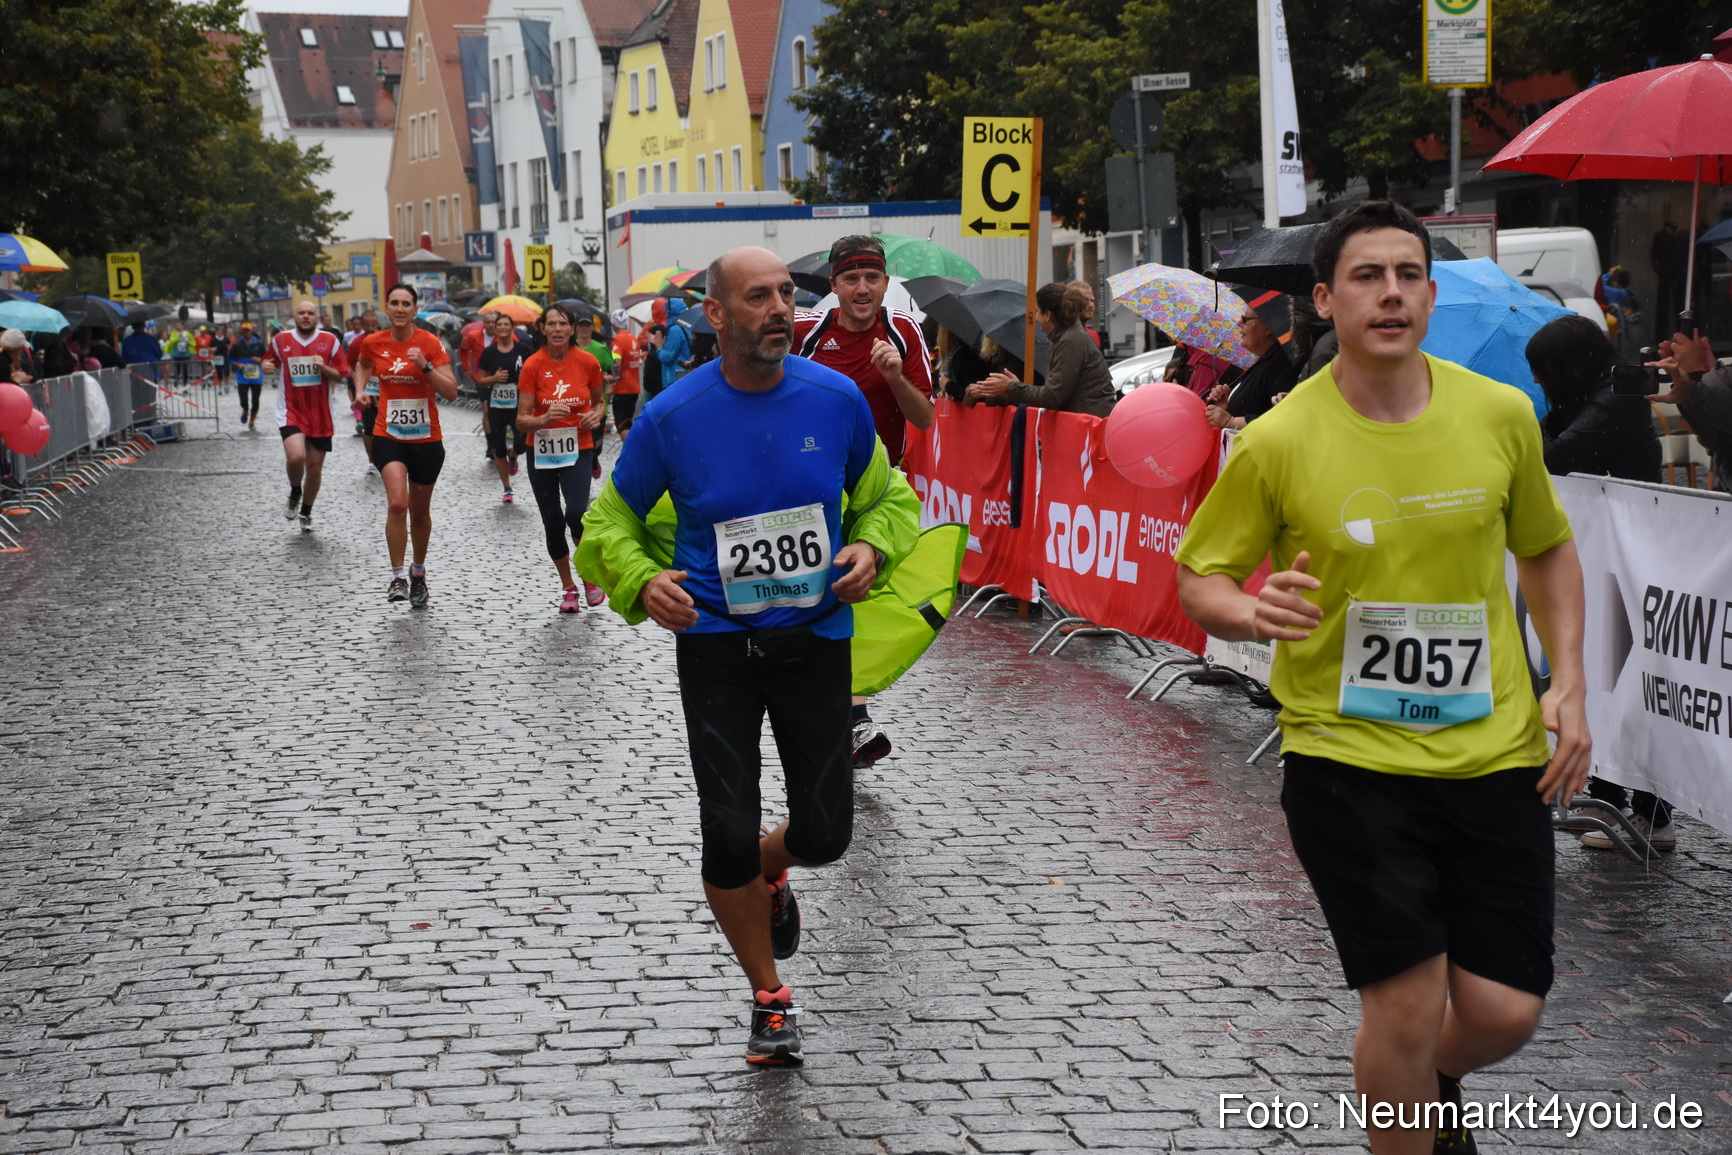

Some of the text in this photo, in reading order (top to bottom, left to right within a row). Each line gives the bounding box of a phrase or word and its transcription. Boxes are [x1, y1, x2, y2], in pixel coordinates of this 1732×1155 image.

[1436, 20, 1478, 29] Marktplatz
[973, 122, 1032, 144] Block
[640, 136, 660, 157] HOTEL
[981, 153, 1021, 212] C
[110, 255, 137, 264] Block
[527, 247, 549, 256] Block
[116, 267, 134, 290] D
[531, 259, 546, 281] D
[291, 363, 320, 376] 3019
[493, 389, 516, 400] 2436
[390, 408, 426, 425] 2531
[538, 437, 575, 455] 3110
[1424, 498, 1463, 509] Neumarkt
[761, 508, 816, 529] BOCK
[724, 527, 758, 538] NeuerMarkt
[729, 530, 823, 578] 2386
[752, 582, 810, 599] Thomas
[1359, 617, 1407, 627] NeuerMarkt
[1416, 608, 1484, 625] BOCK
[1642, 584, 1718, 665] BMW
[1359, 634, 1483, 688] 2057
[1347, 674, 1355, 685] A
[1397, 697, 1440, 720] Tom
[1641, 671, 1723, 736] WENIGER
